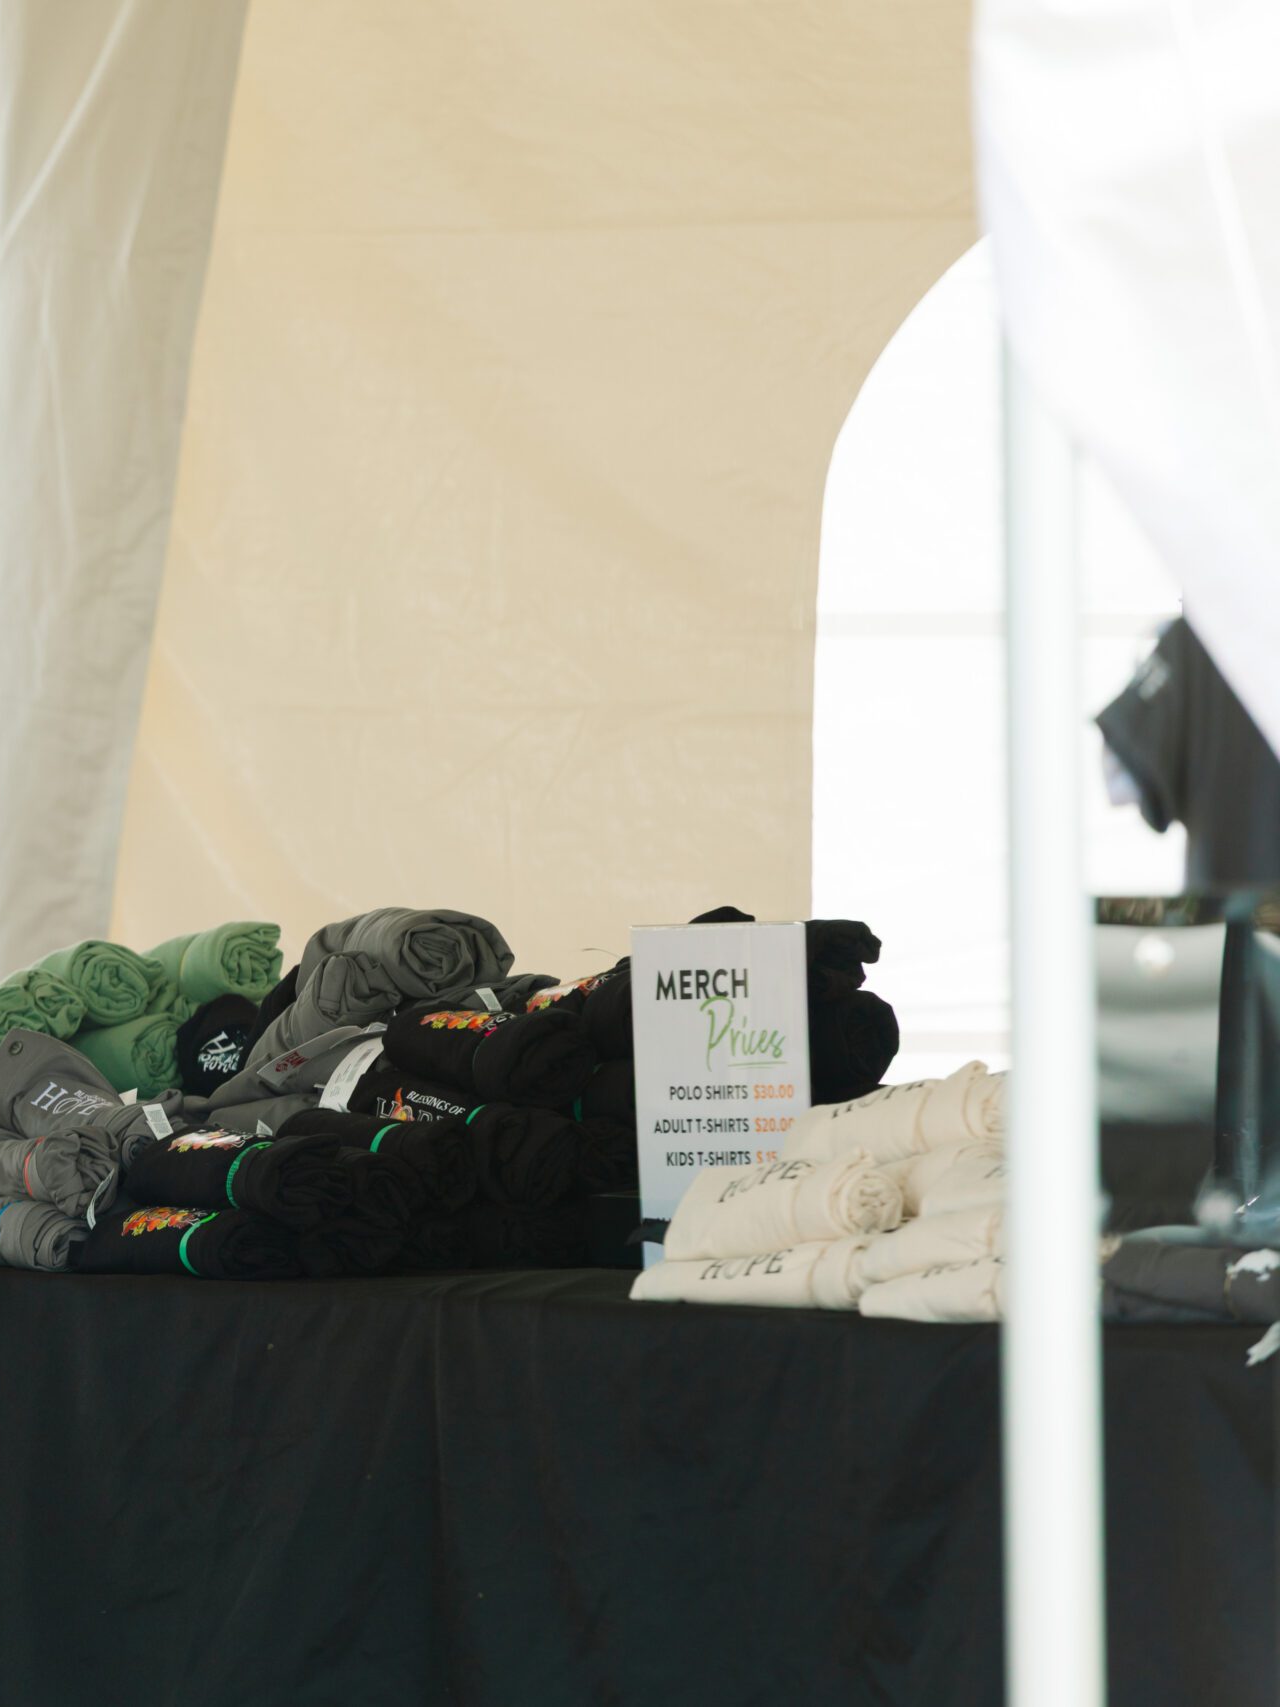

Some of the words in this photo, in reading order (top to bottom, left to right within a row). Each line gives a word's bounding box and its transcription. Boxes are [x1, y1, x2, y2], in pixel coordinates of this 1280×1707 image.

[656, 967, 748, 1000] MERCH
[699, 995, 786, 1072] Prices
[406, 1090, 451, 1111] BLESSINGS
[448, 1105, 466, 1116] OF
[669, 1085, 702, 1100] POLO
[705, 1084, 748, 1100] SHIRTS
[753, 1083, 795, 1100] $30.00
[654, 1117, 693, 1133] ADULT
[695, 1117, 750, 1133] T-SHIRTS
[666, 1151, 694, 1166] KIDS
[697, 1150, 751, 1166] T-SHIRTS
[718, 1160, 813, 1203] HOPE
[699, 1248, 794, 1281] HOPE
